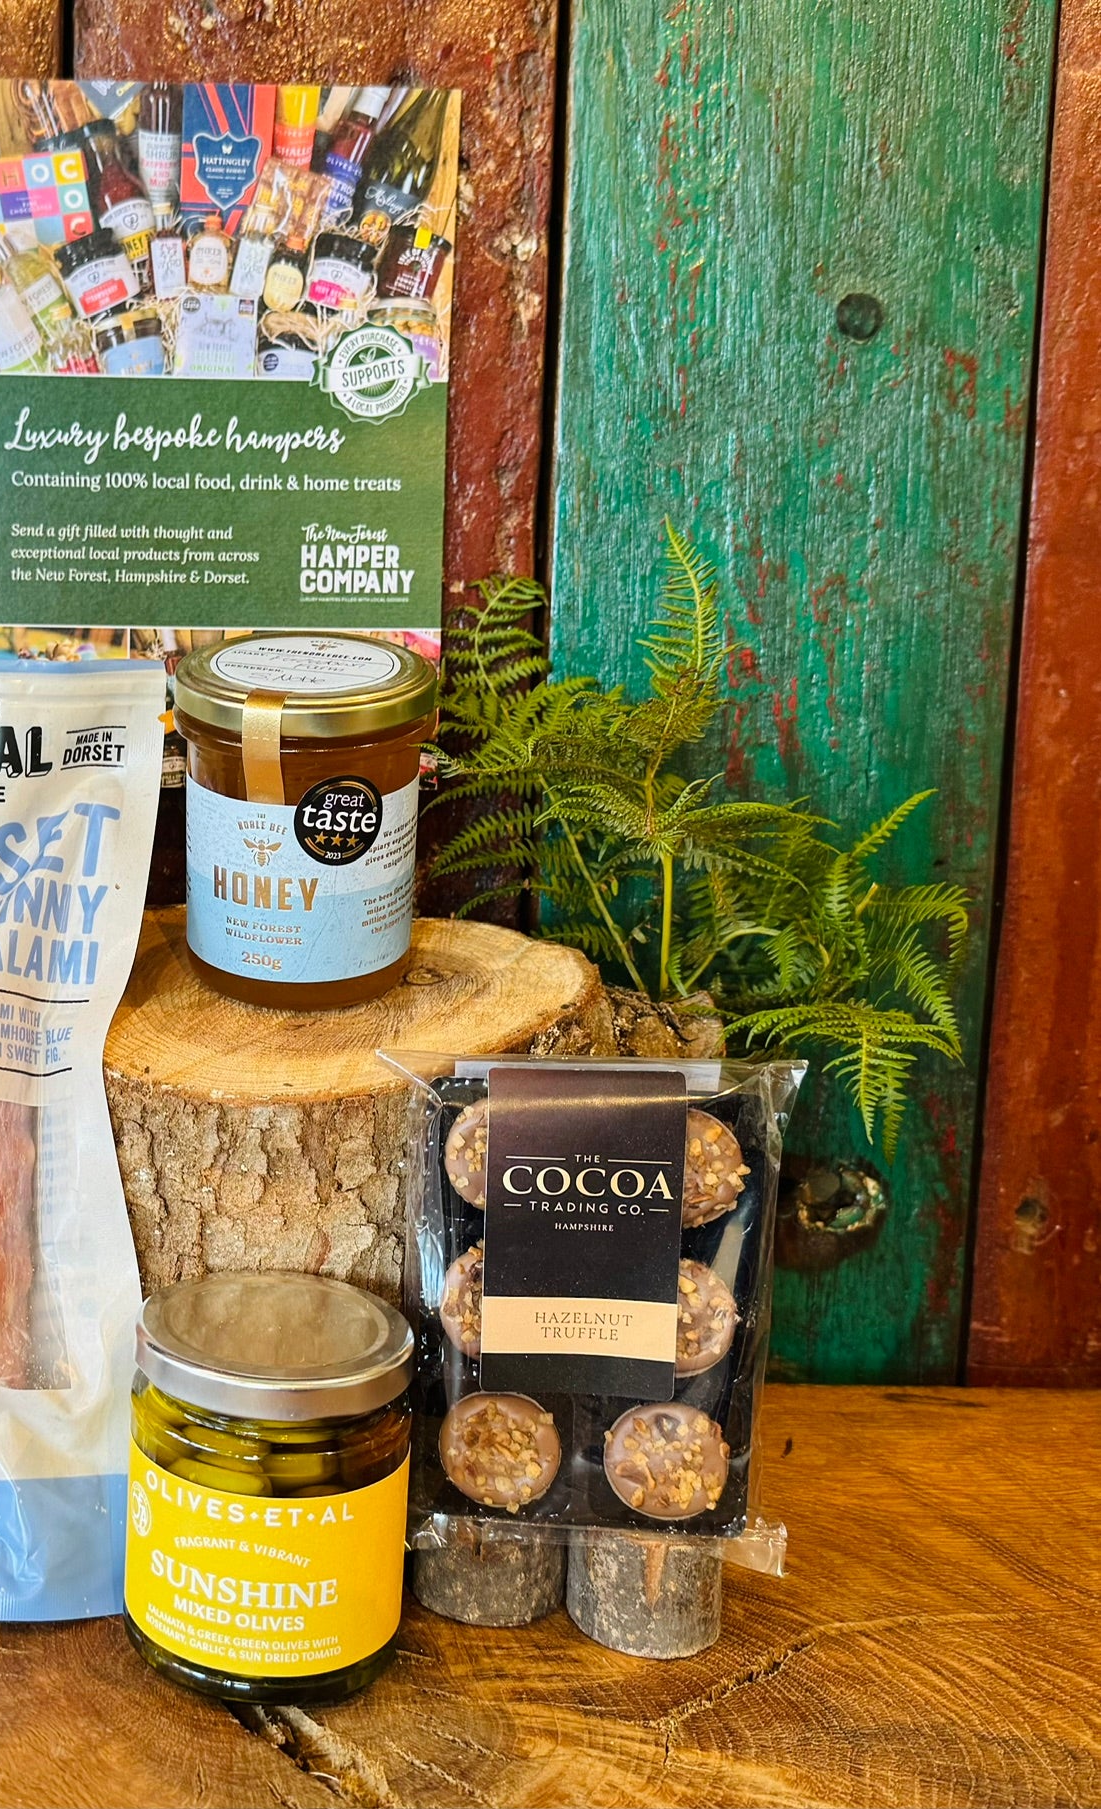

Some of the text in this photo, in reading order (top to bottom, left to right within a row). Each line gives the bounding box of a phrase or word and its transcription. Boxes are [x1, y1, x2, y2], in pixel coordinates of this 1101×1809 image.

[339, 336, 359, 359] EVERY
[360, 333, 398, 349] PURCHASE
[342, 360, 405, 388] SUPPORTS
[346, 385, 408, 414] A LOCAL PRODUCER
[4, 406, 346, 464] Luxury bespoke hampers
[11, 470, 402, 492] Containing 100% local food, drink & home treats
[10, 523, 234, 543] Send a gift filled with thought and
[301, 522, 389, 544] The New Forest
[10, 546, 260, 565] exceptional local products from across
[300, 544, 400, 569] HAMPER
[10, 567, 250, 586] the New Forest, Hampshire & Dorset.
[299, 569, 416, 594] COMPANY
[75, 731, 112, 746] MADE IN
[62, 744, 125, 766] DORSET
[324, 791, 366, 810] great
[237, 820, 288, 836] NOBLE BEE
[302, 805, 377, 835] taste
[324, 851, 341, 861] 2023
[213, 864, 319, 912] HONEY
[226, 915, 302, 934] NEW FOREST
[225, 927, 303, 946] WILDFLOWER
[241, 951, 283, 971] 250g
[18, 1007, 41, 1027] WITH
[46, 1026, 73, 1047] BLUE
[6, 1046, 41, 1065] SWEET
[45, 1048, 61, 1066] FIG.
[574, 1154, 601, 1164] THE
[502, 1165, 674, 1200] COCOA
[529, 1200, 645, 1216] TRADING CO.
[554, 1222, 614, 1232] HAMPSHIRE
[534, 1311, 633, 1327] HAZELNUT
[540, 1326, 619, 1341] TRUFFLE
[174, 1536, 311, 1569] FRAGRANT & VIBRANT
[150, 1549, 339, 1610] SUNSHINE
[173, 1594, 306, 1632] MIXED OLIVES
[145, 1612, 342, 1663] ROSEMARY, GARLIC & SUN DRIED TOMATO
[147, 1603, 339, 1651] KALAMATA & GREEK GREEN OLIVES WITH
